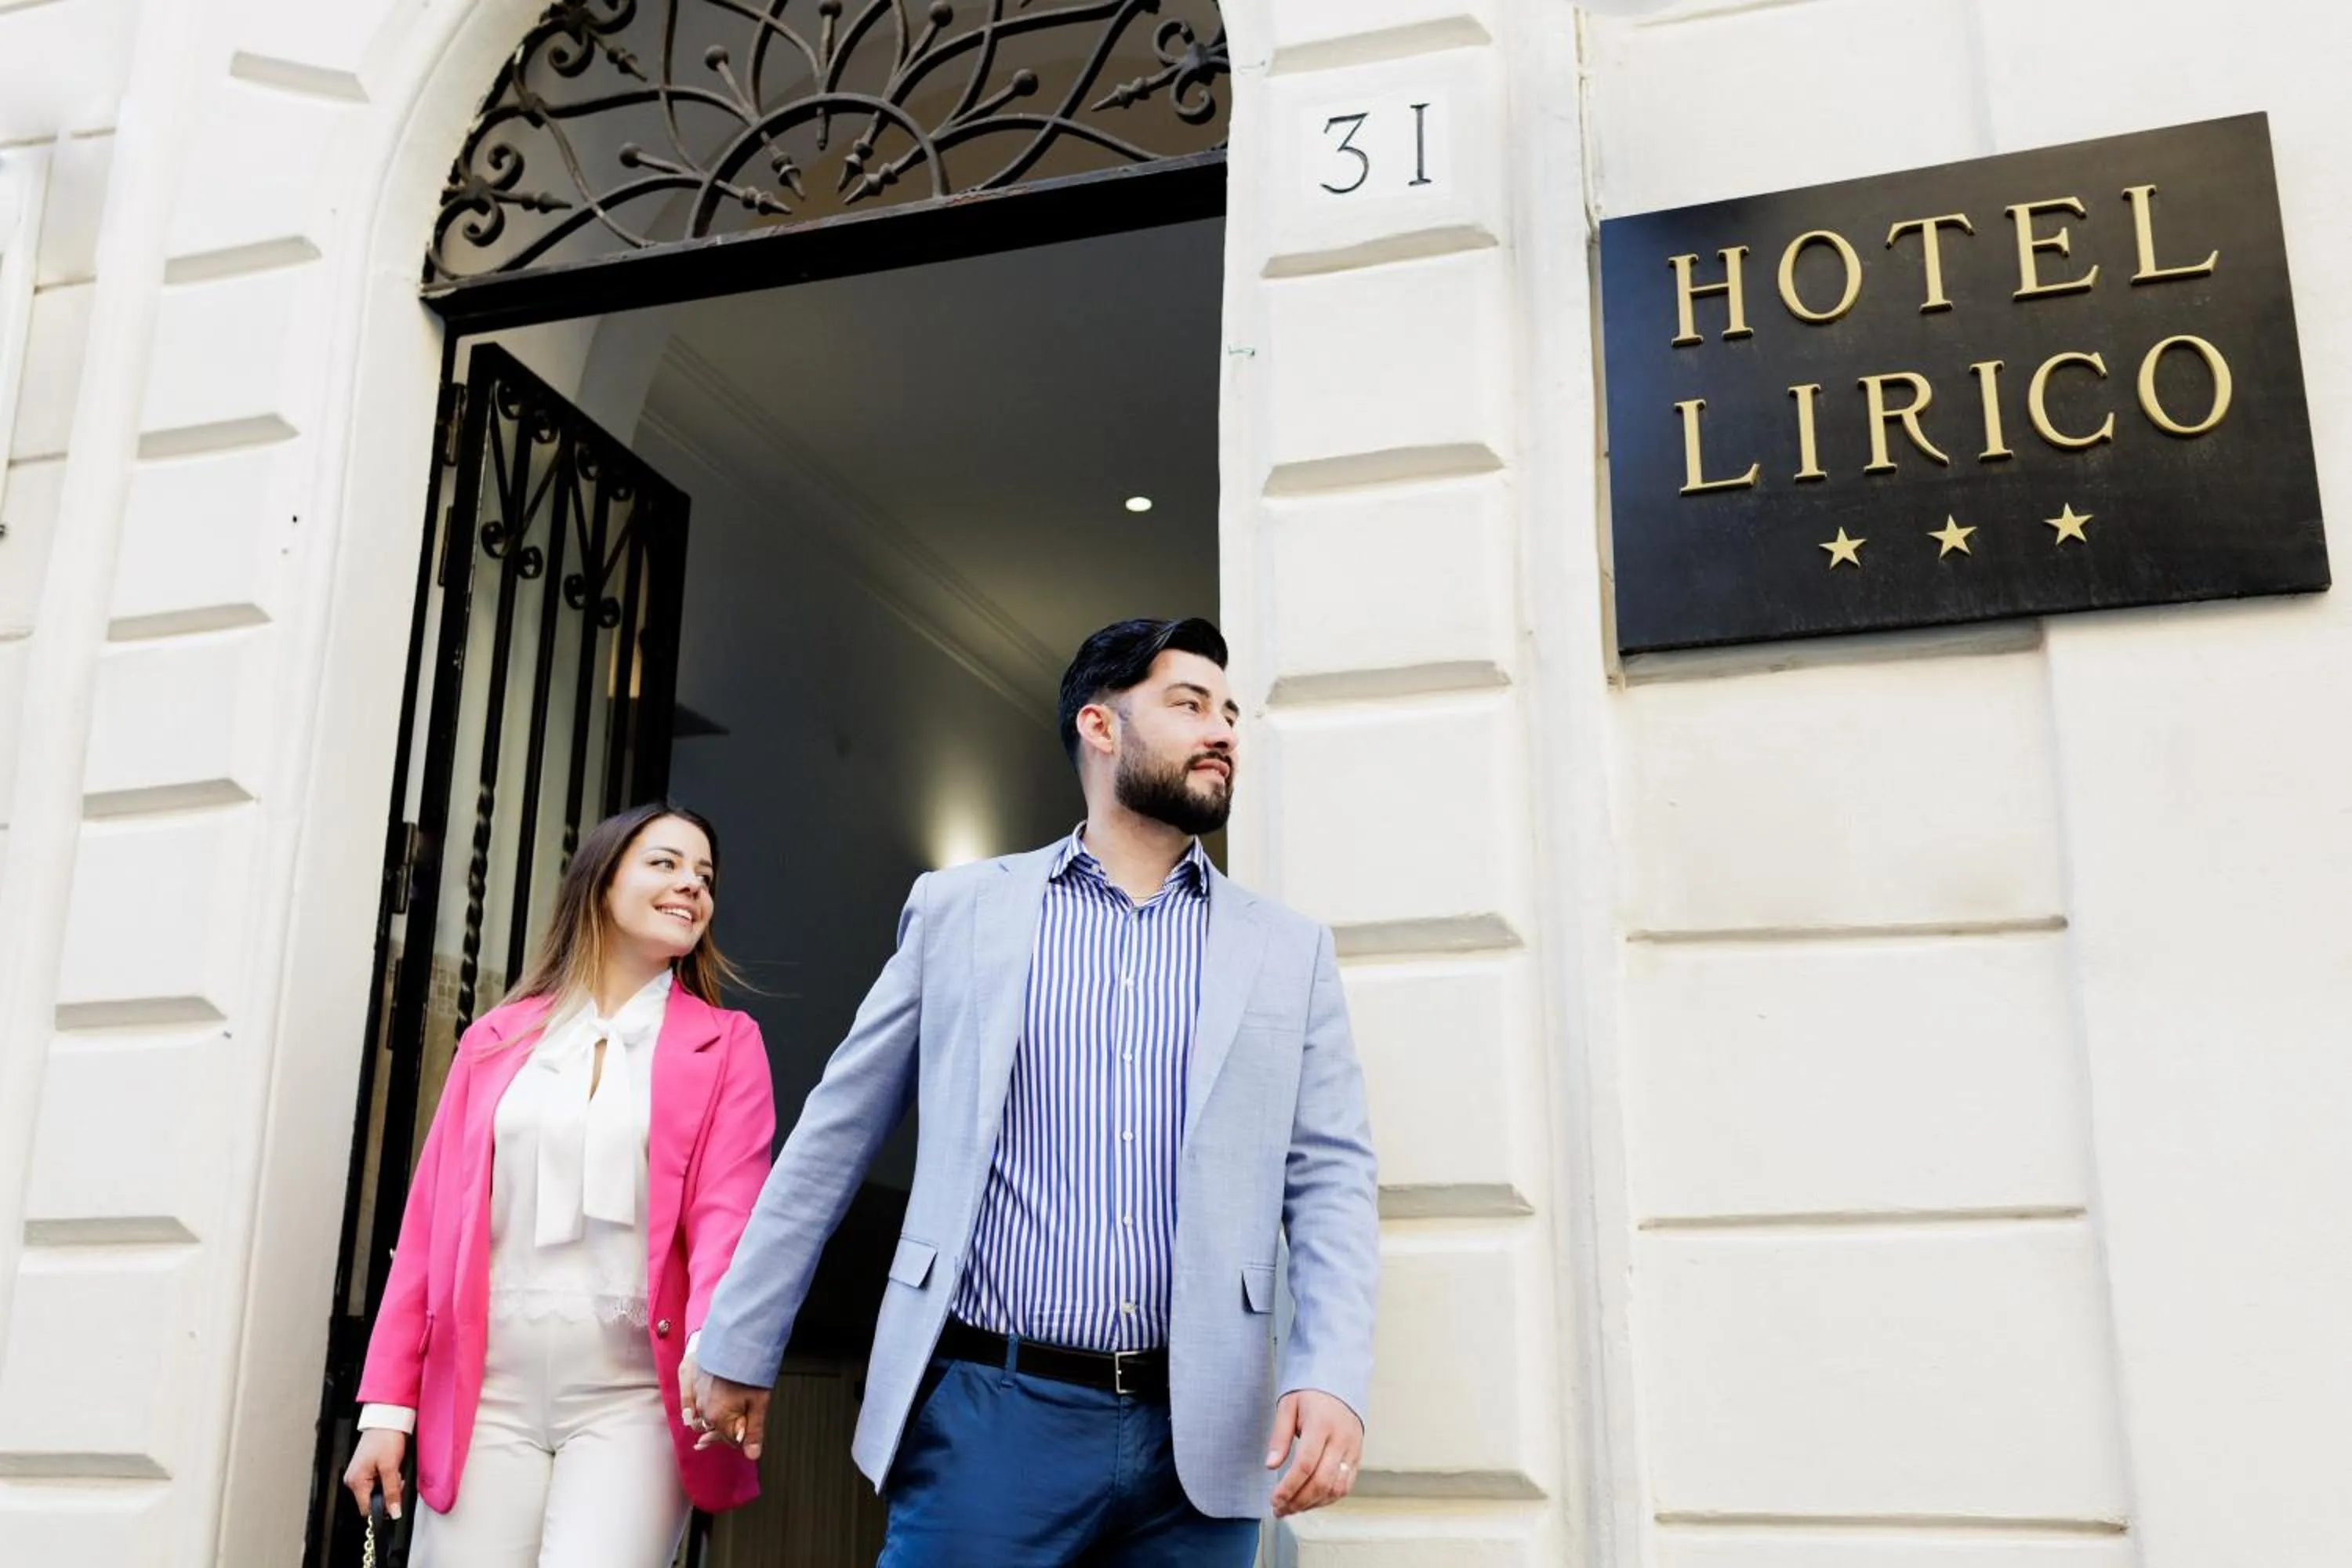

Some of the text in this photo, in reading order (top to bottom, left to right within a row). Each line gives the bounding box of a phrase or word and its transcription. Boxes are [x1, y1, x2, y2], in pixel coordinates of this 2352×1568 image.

[1319, 103, 1432, 194] 31
[1668, 183, 2220, 347] HOTEL
[1674, 334, 2233, 496] LIRICO
